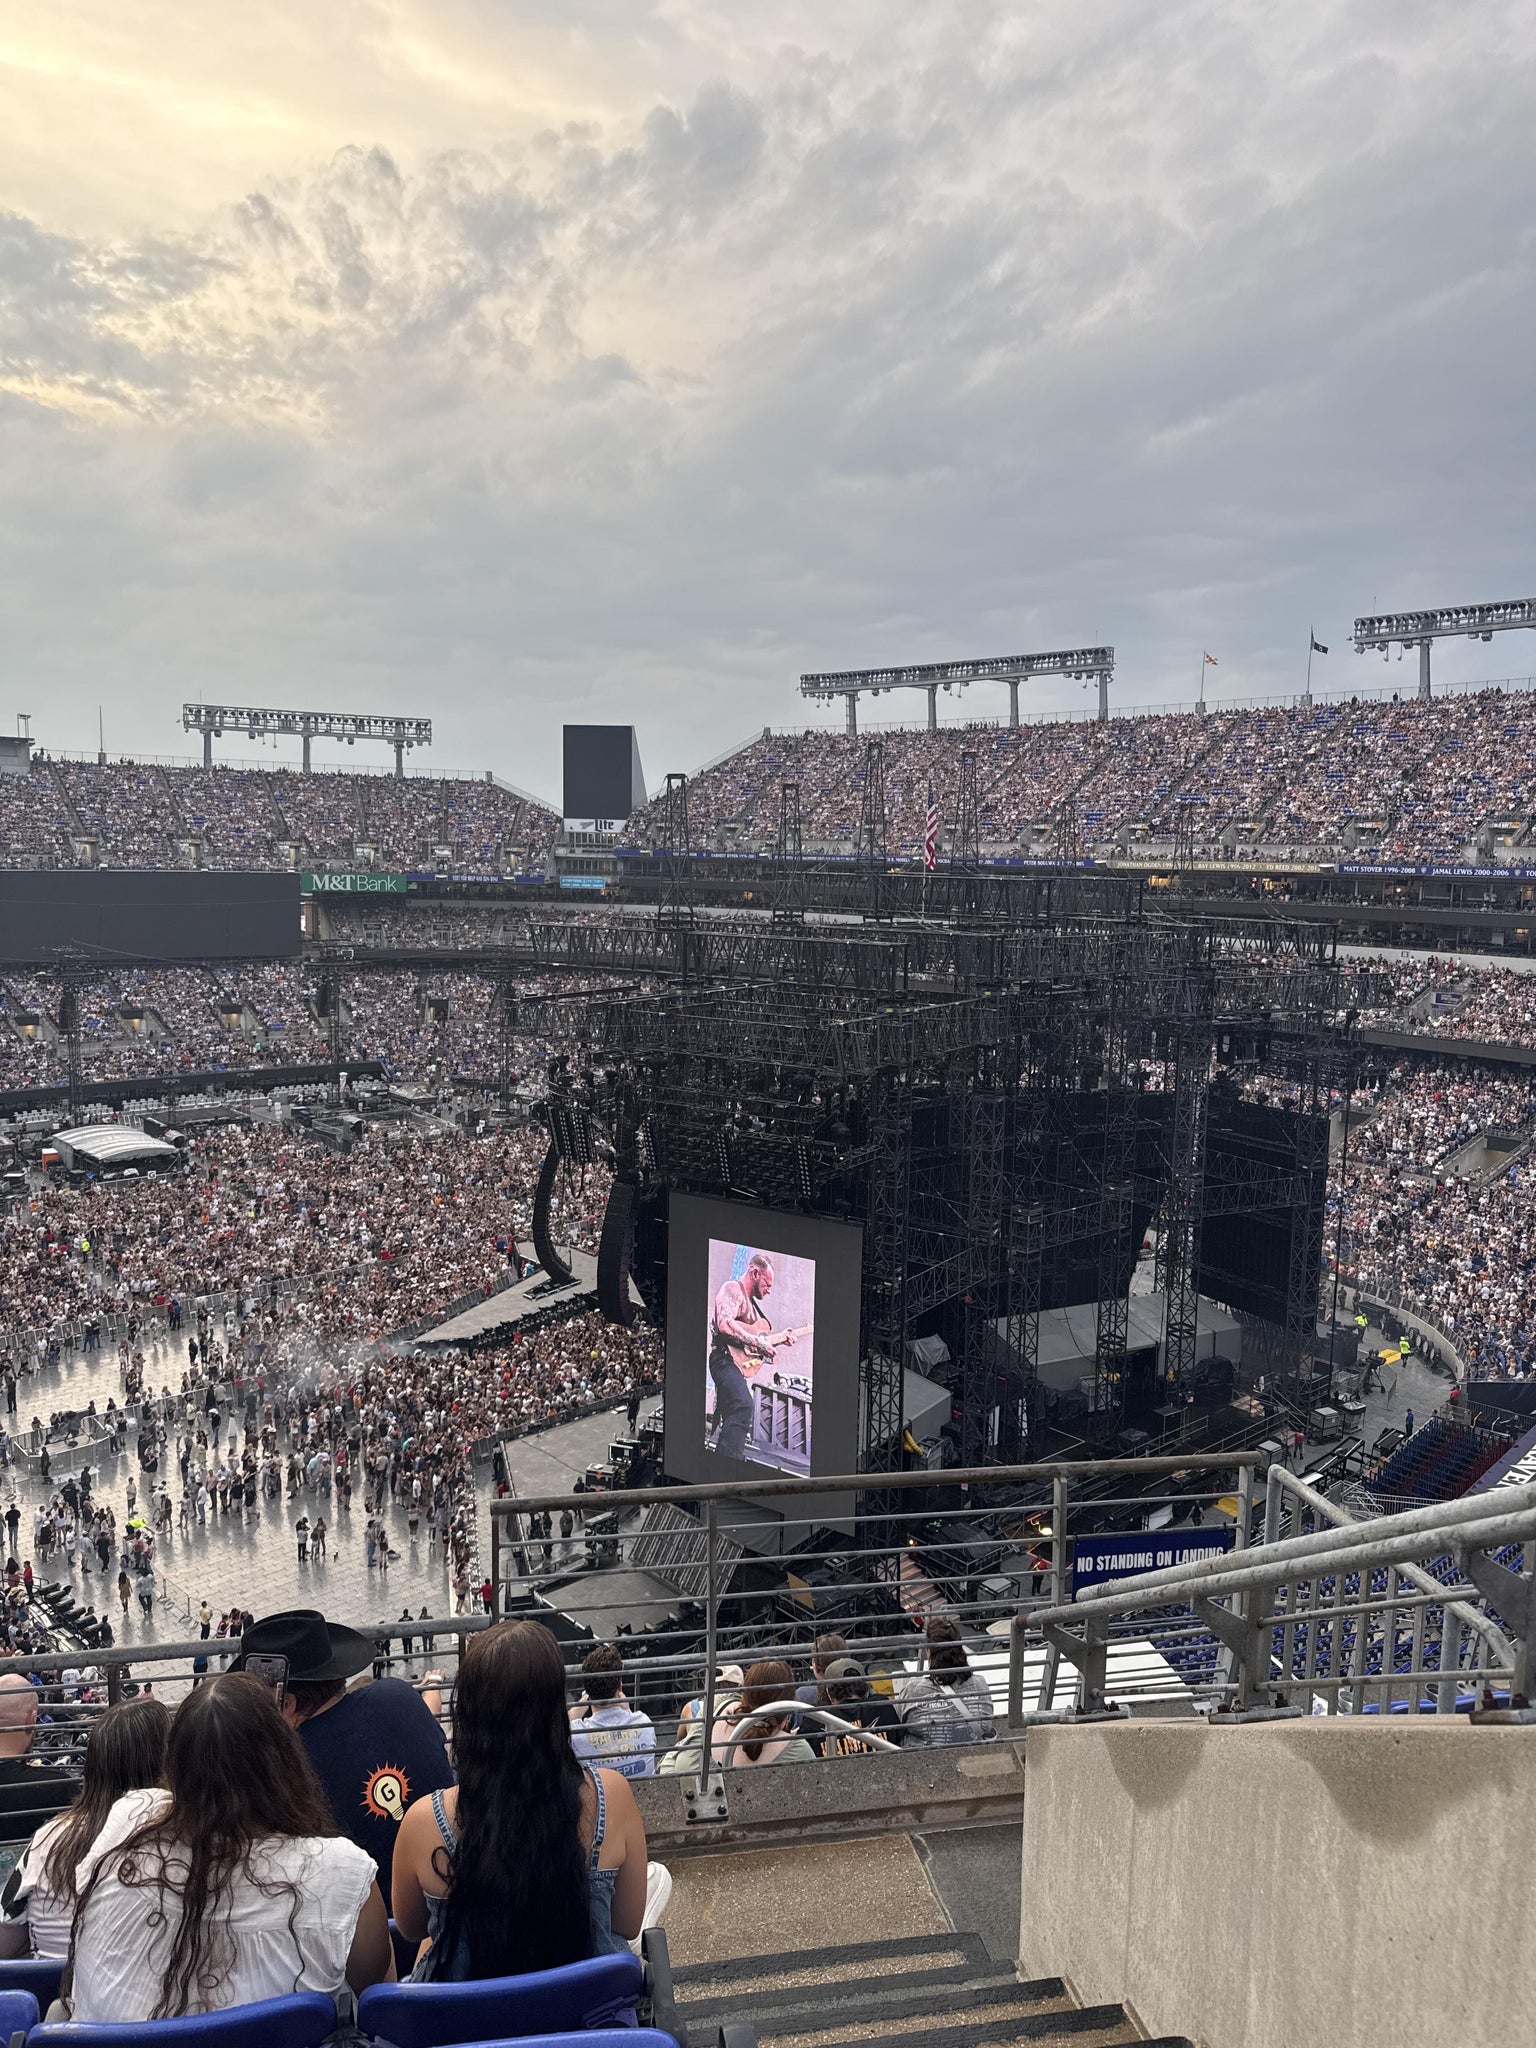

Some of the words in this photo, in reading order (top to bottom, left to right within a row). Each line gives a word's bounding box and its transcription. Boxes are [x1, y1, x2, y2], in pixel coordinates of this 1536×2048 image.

[594, 819, 614, 832] Lite
[1118, 861, 1143, 869] JONATHAN
[1384, 866, 1416, 874] 1996-2008
[1432, 868, 1452, 876] JAMAL
[1474, 868, 1510, 876] 2000-2006
[311, 874, 355, 891] M&T
[356, 874, 398, 892] Bank
[1077, 1556, 1093, 1573] NO
[1096, 1551, 1153, 1571] STANDING
[1156, 1550, 1172, 1566] ON
[1175, 1546, 1224, 1565] LANDING
[616, 1763, 639, 1775] EPT.
[380, 1782, 396, 1802] G
